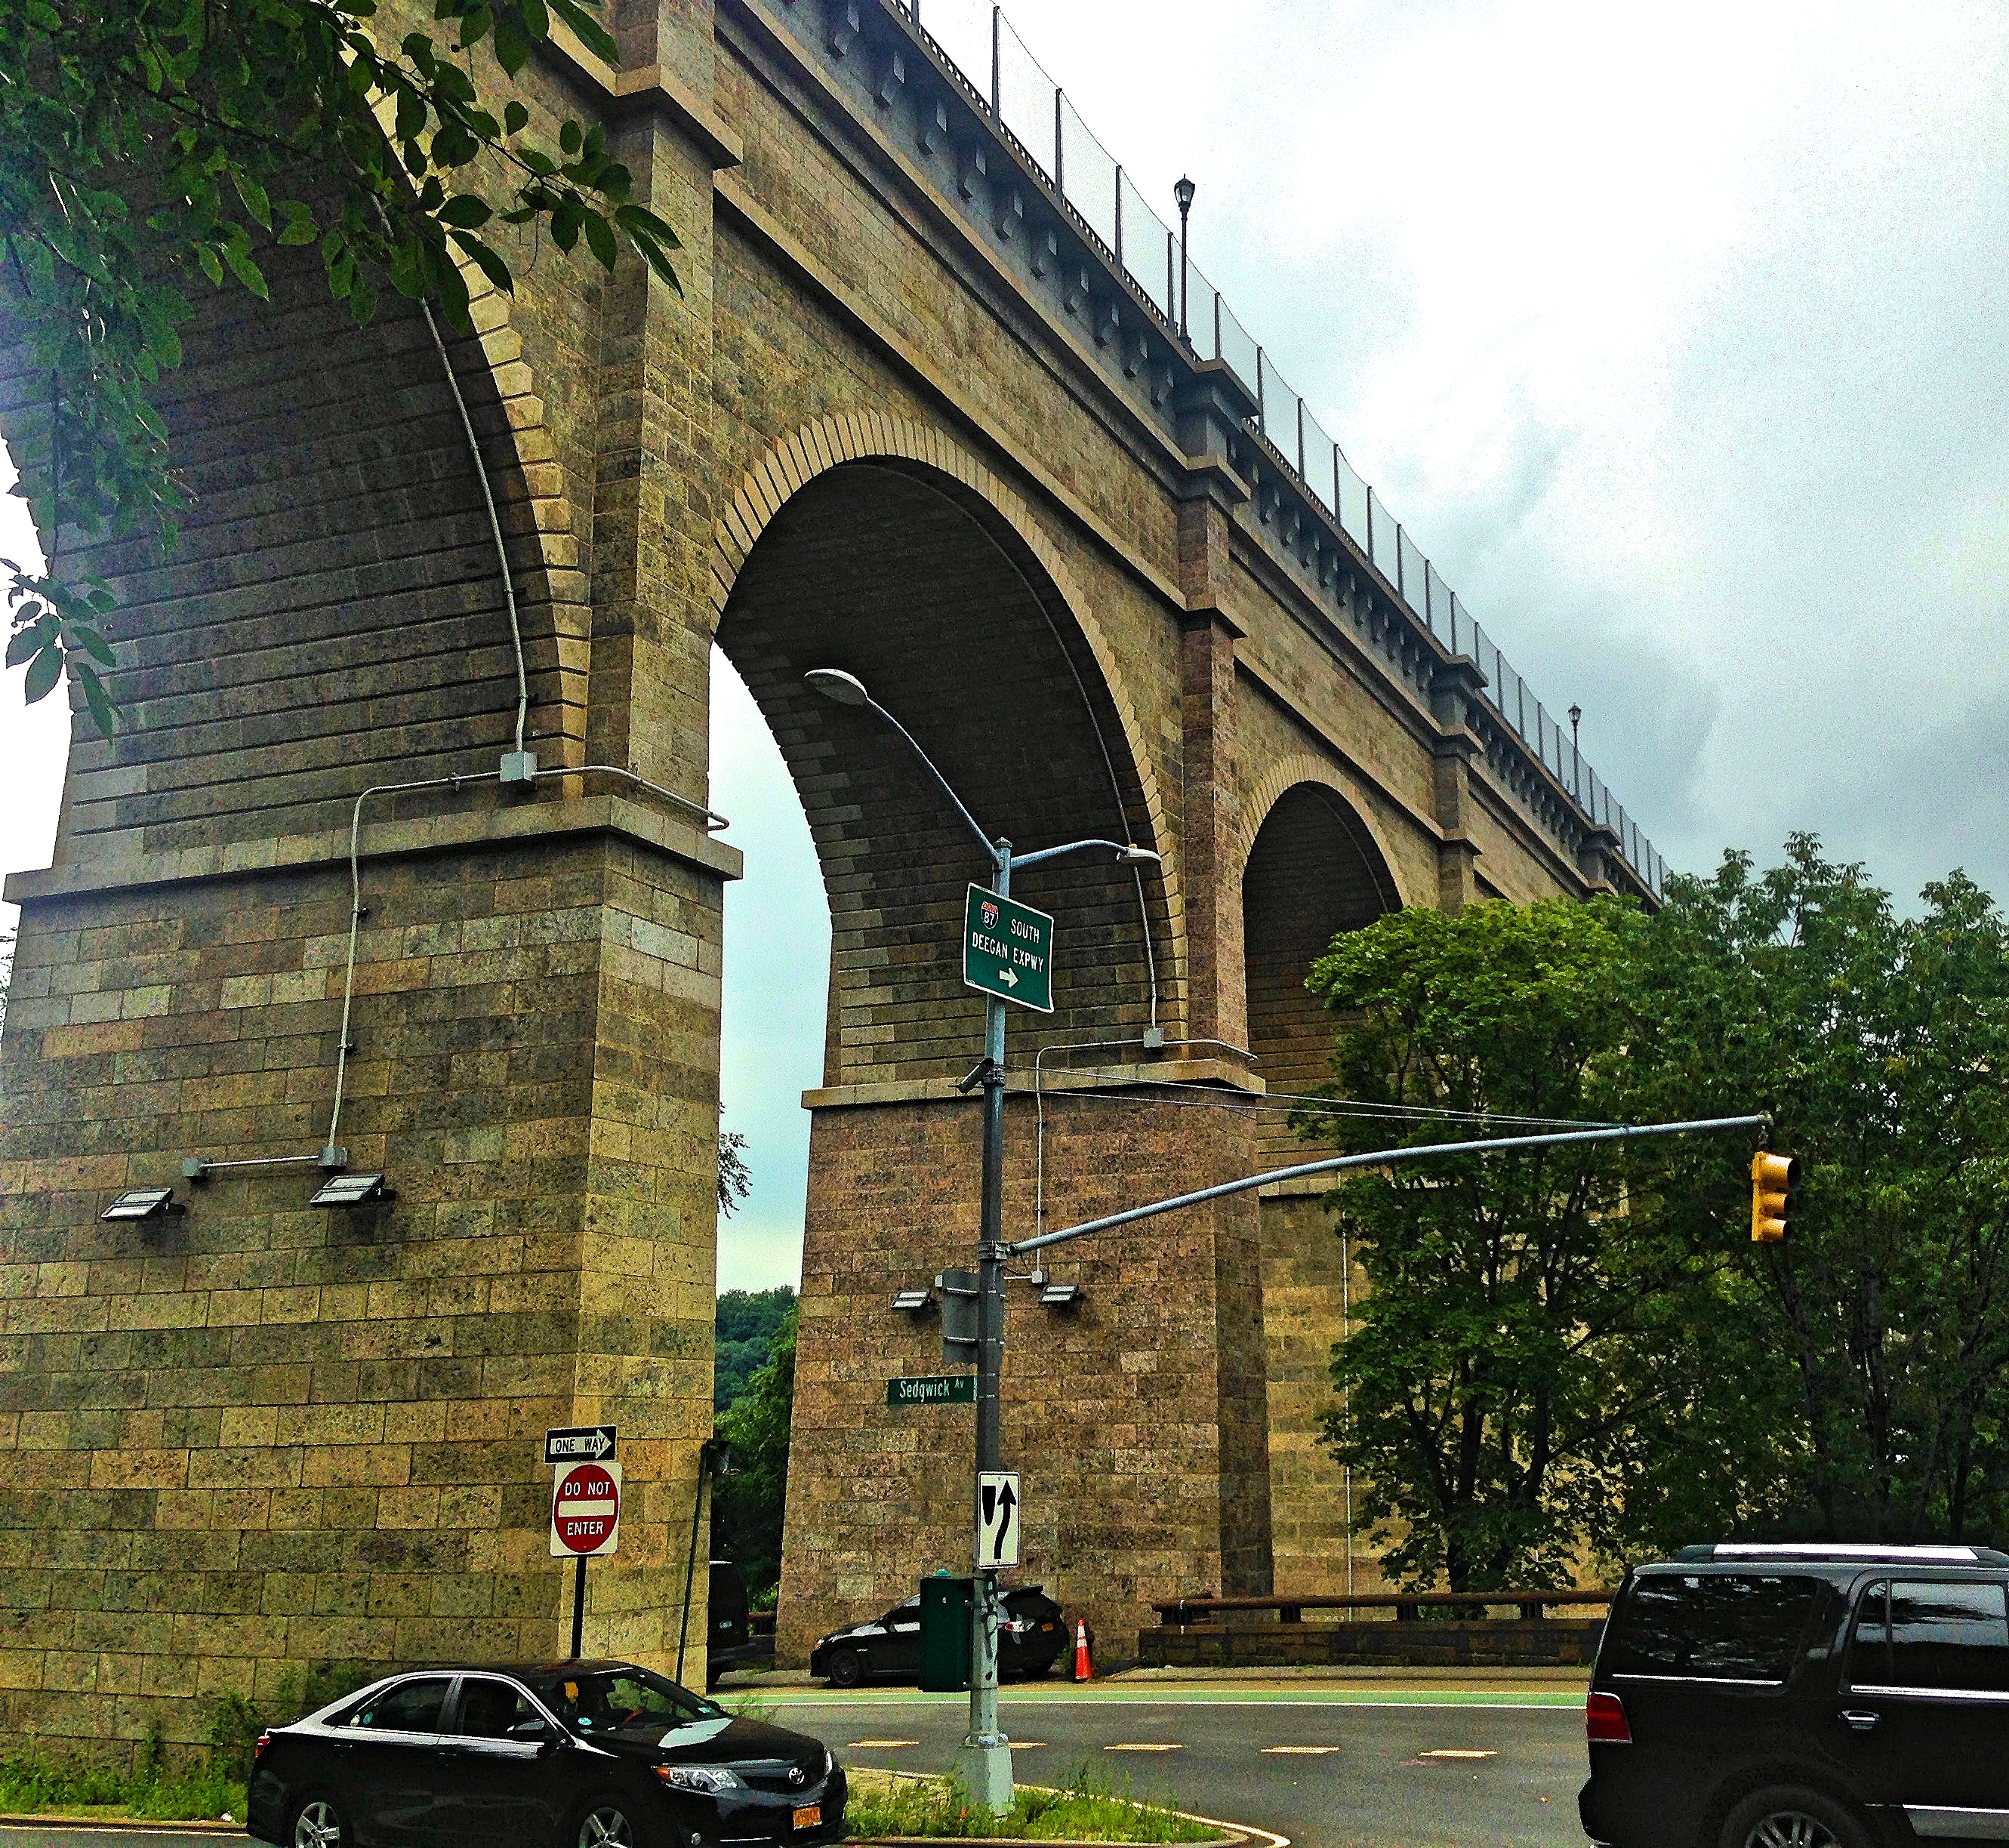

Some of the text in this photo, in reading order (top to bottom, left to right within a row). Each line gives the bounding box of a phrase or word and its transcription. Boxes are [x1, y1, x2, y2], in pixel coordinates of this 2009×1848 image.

[984, 911, 995, 926] 87
[1010, 918, 1040, 944] SOUTH
[972, 931, 1044, 973] DEEGAN EXPWY
[899, 1378, 964, 1402] Sedgwick Av
[555, 1437, 605, 1453] ONE WAY
[565, 1481, 611, 1495] DO NOT
[567, 1521, 603, 1535] ENTER
